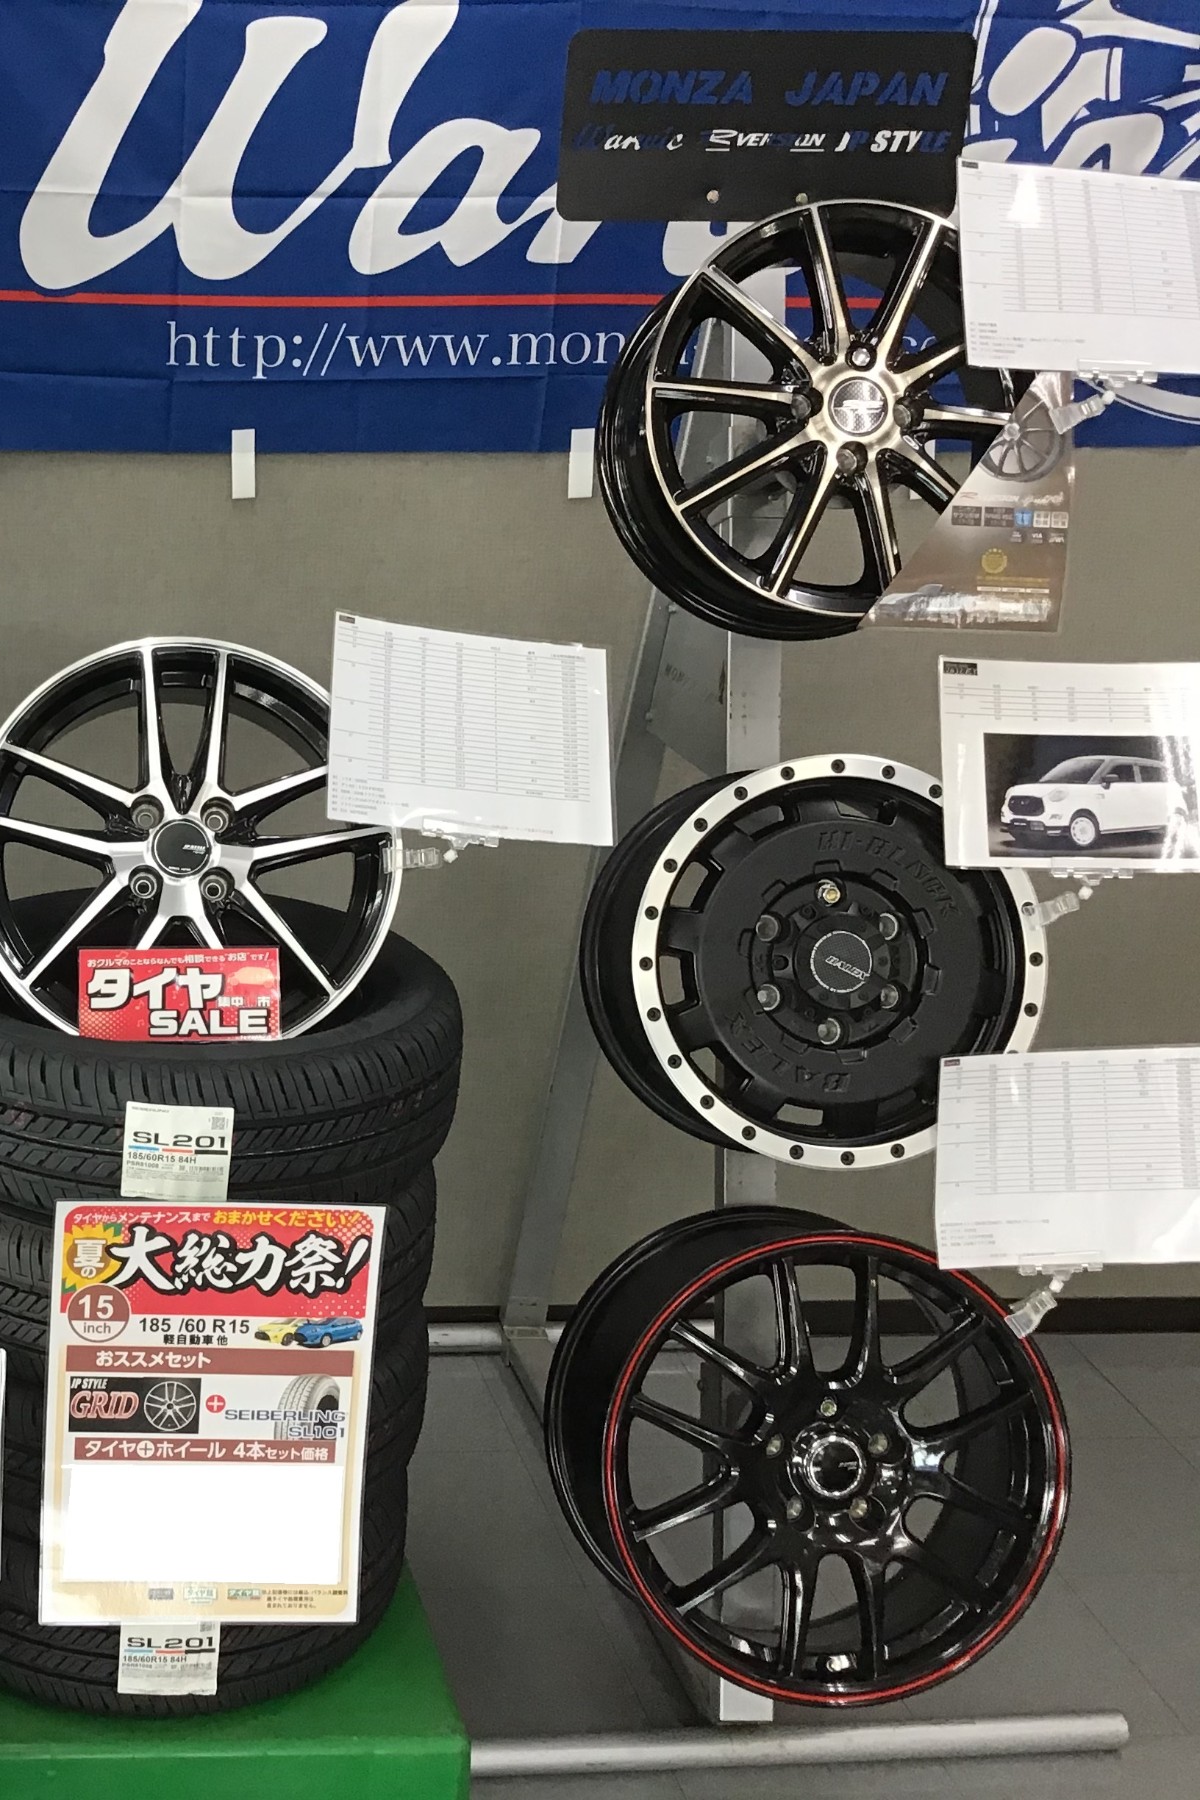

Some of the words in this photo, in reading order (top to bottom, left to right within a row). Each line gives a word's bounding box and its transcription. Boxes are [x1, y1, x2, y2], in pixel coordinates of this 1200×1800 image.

[589, 70, 753, 105] MONZA
[784, 71, 949, 107] JAPAN
[869, 129, 952, 153] STYLE
[167, 321, 627, 380] http://www.mon
[87, 967, 223, 1010] タイヤ
[150, 1009, 268, 1036] SALE
[132, 1131, 226, 1148] SL201
[127, 1151, 176, 1163] 185/60R15
[178, 1156, 197, 1164] 84H
[78, 1294, 115, 1319] 15
[82, 1320, 112, 1335] inch
[138, 1317, 172, 1333] 185
[162, 1333, 229, 1346] 軽自動車他
[96, 1350, 212, 1369] おススメセット
[82, 1378, 108, 1390] STYLE
[69, 1390, 140, 1420] GRID
[224, 1408, 347, 1424] SEIBERLING
[289, 1425, 345, 1440] SL101
[127, 1636, 213, 1649] SL201
